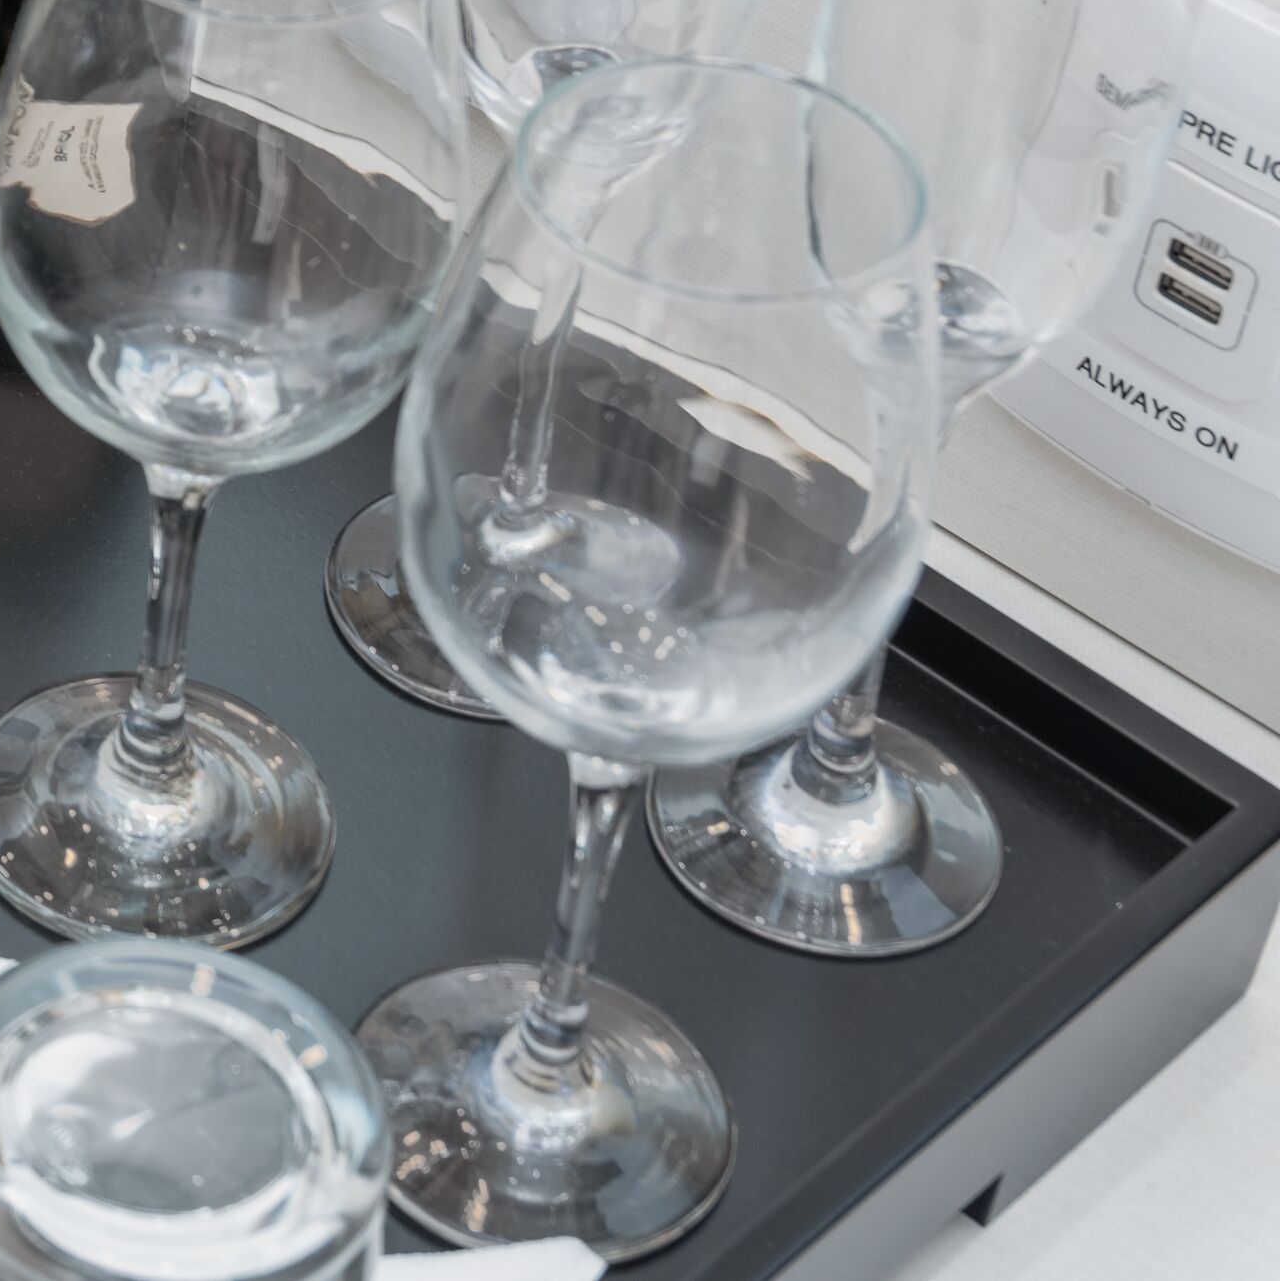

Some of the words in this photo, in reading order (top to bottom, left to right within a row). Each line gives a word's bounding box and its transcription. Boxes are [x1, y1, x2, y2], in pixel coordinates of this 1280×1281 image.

[1177, 108, 1238, 158] PRE
[1076, 355, 1188, 433] ALWAYS
[1194, 427, 1239, 461] ON
